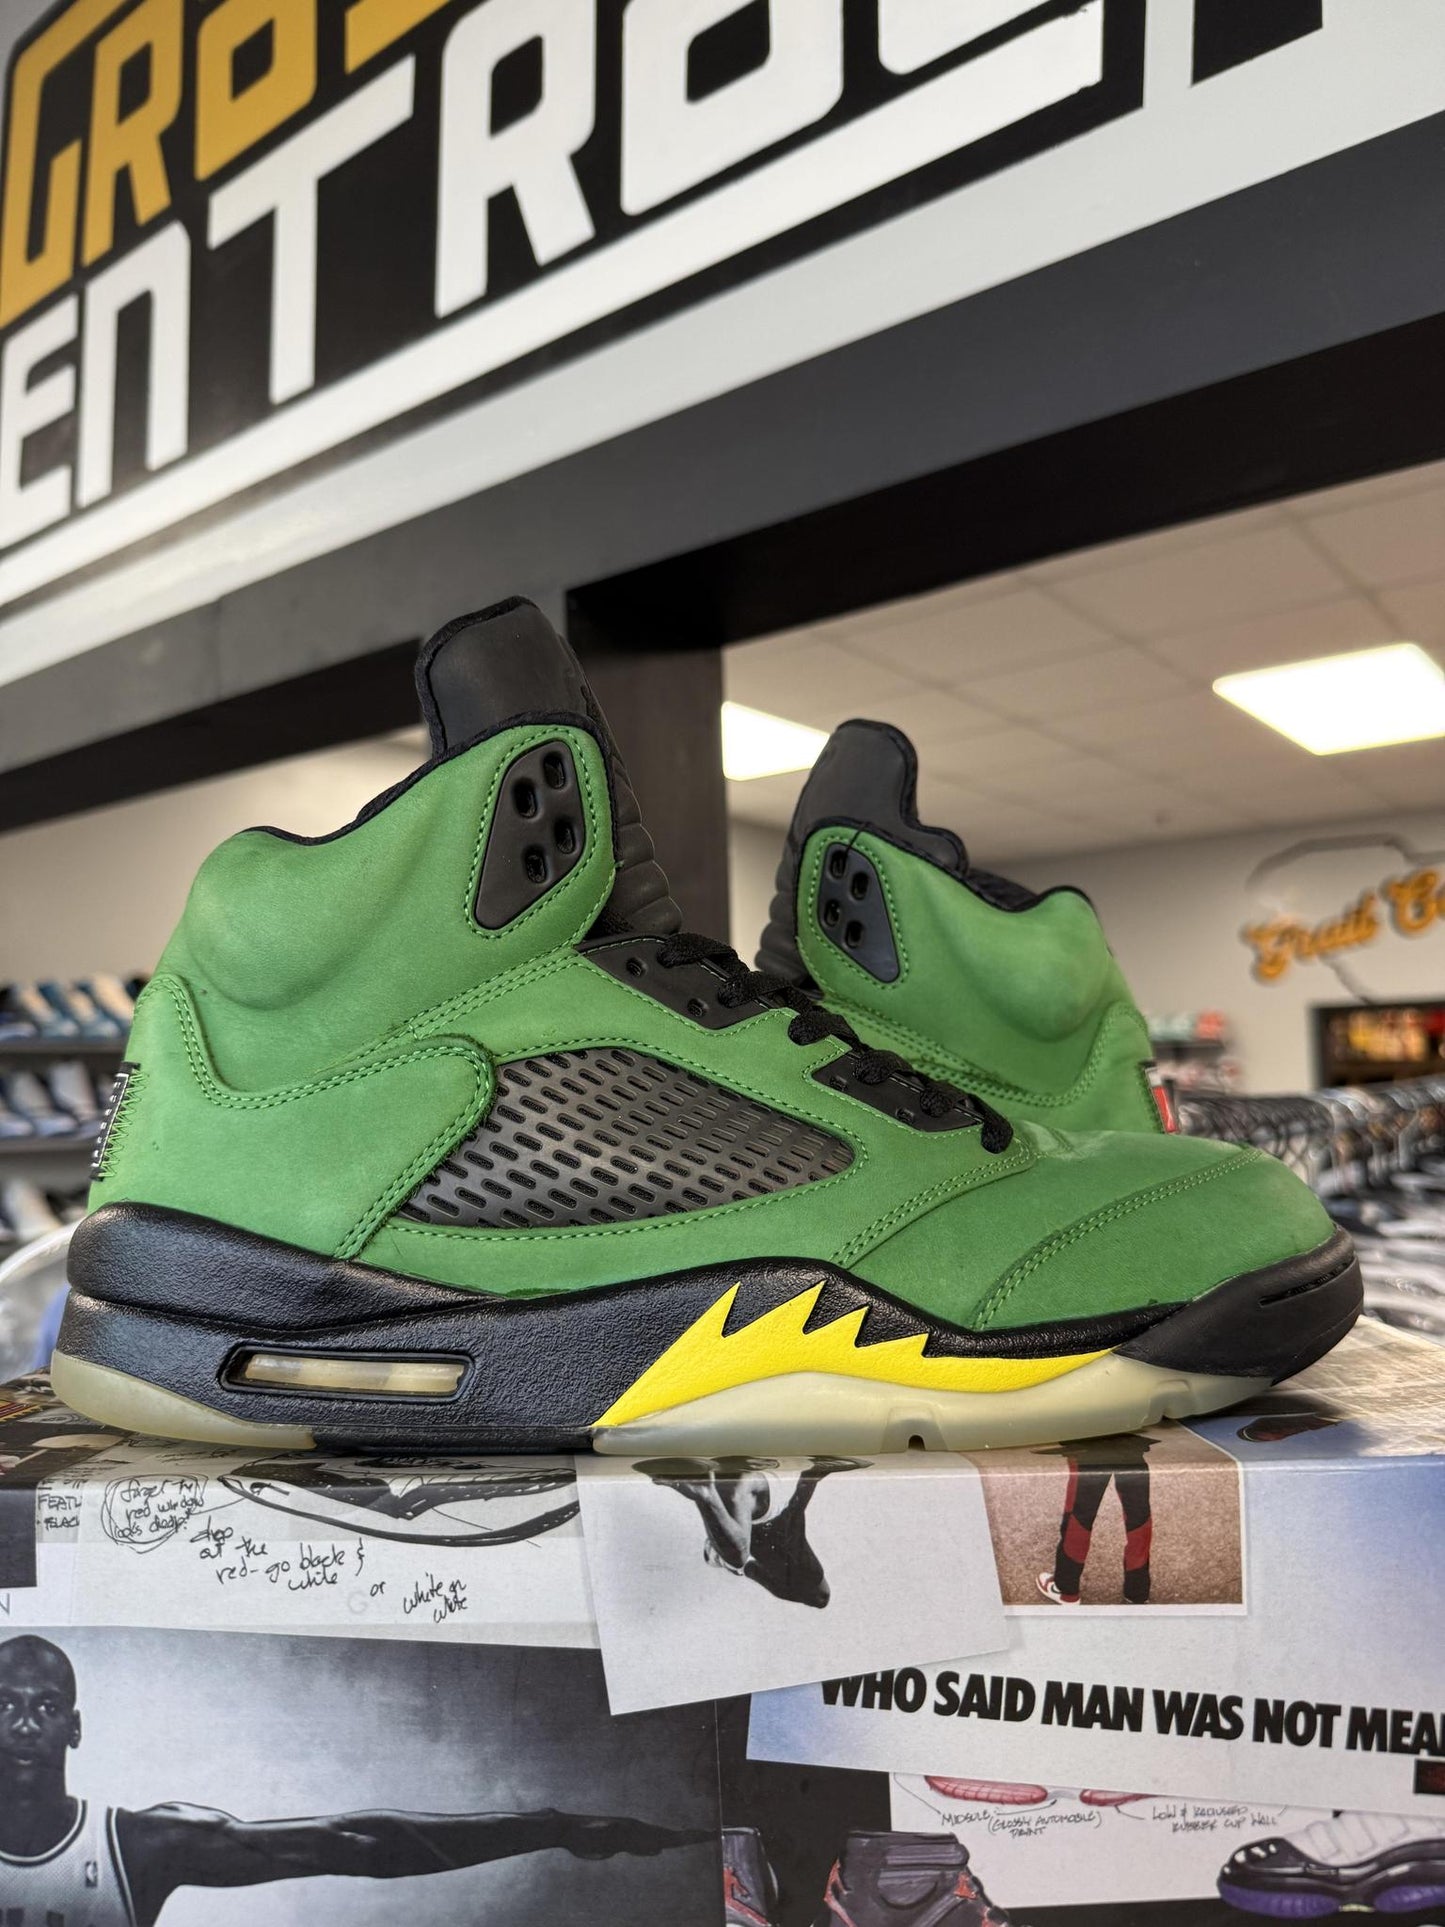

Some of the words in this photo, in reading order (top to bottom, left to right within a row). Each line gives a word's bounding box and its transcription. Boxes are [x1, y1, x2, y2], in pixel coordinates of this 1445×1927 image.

[299, 1543, 346, 1570] black
[288, 1571, 338, 1591] white
[369, 1581, 386, 1597] or
[403, 1572, 443, 1615] white
[822, 1667, 927, 1713] WHO
[933, 1670, 1036, 1722] SAID
[1040, 1681, 1144, 1732] MAN
[1152, 1689, 1244, 1740] WAS
[1252, 1698, 1342, 1748] NOT
